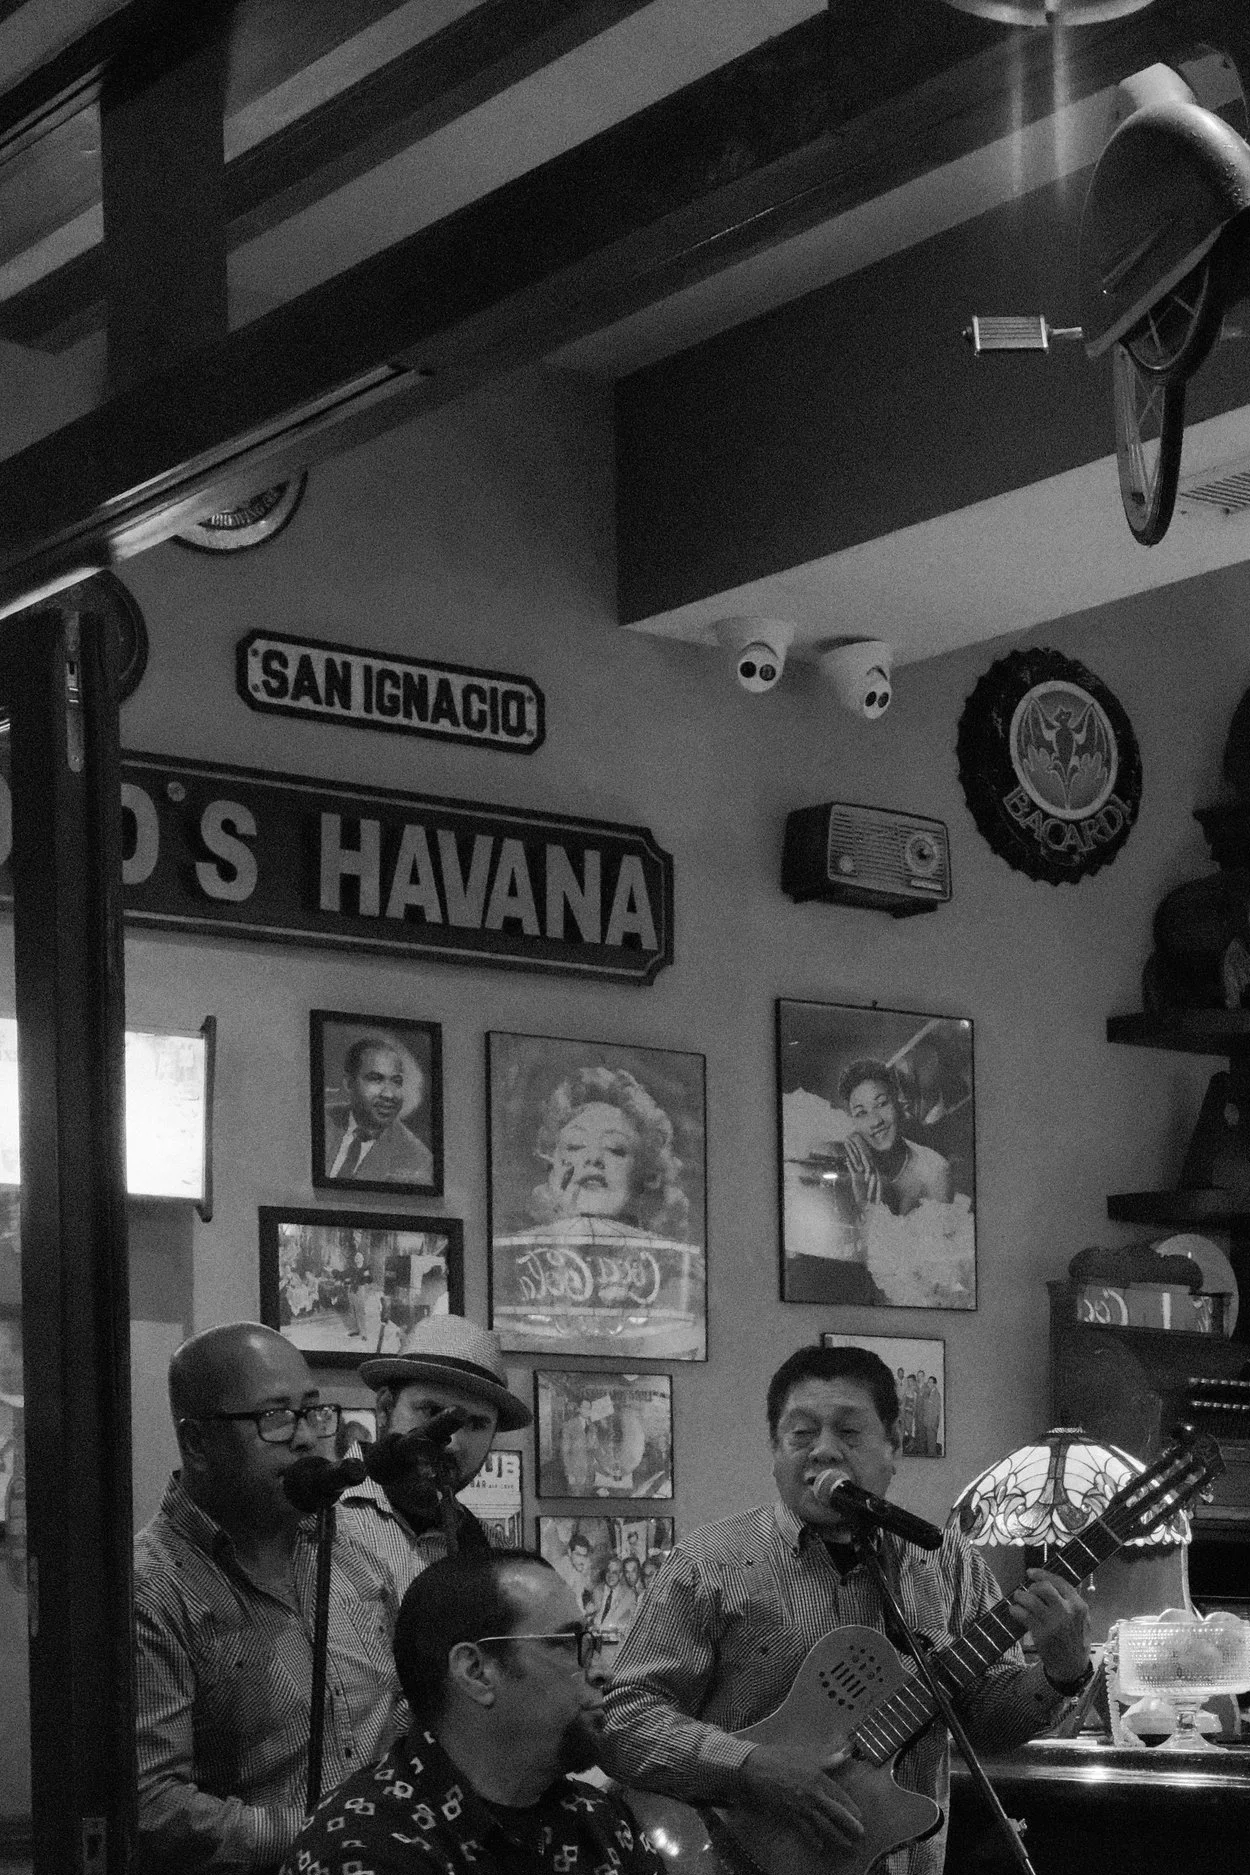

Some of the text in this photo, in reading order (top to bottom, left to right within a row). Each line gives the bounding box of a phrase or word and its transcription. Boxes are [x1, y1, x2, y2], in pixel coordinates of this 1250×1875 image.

[262, 650, 527, 737] SAN IGNACIO
[1003, 786, 1132, 851] BACARDI
[319, 811, 658, 951] HAVANA
